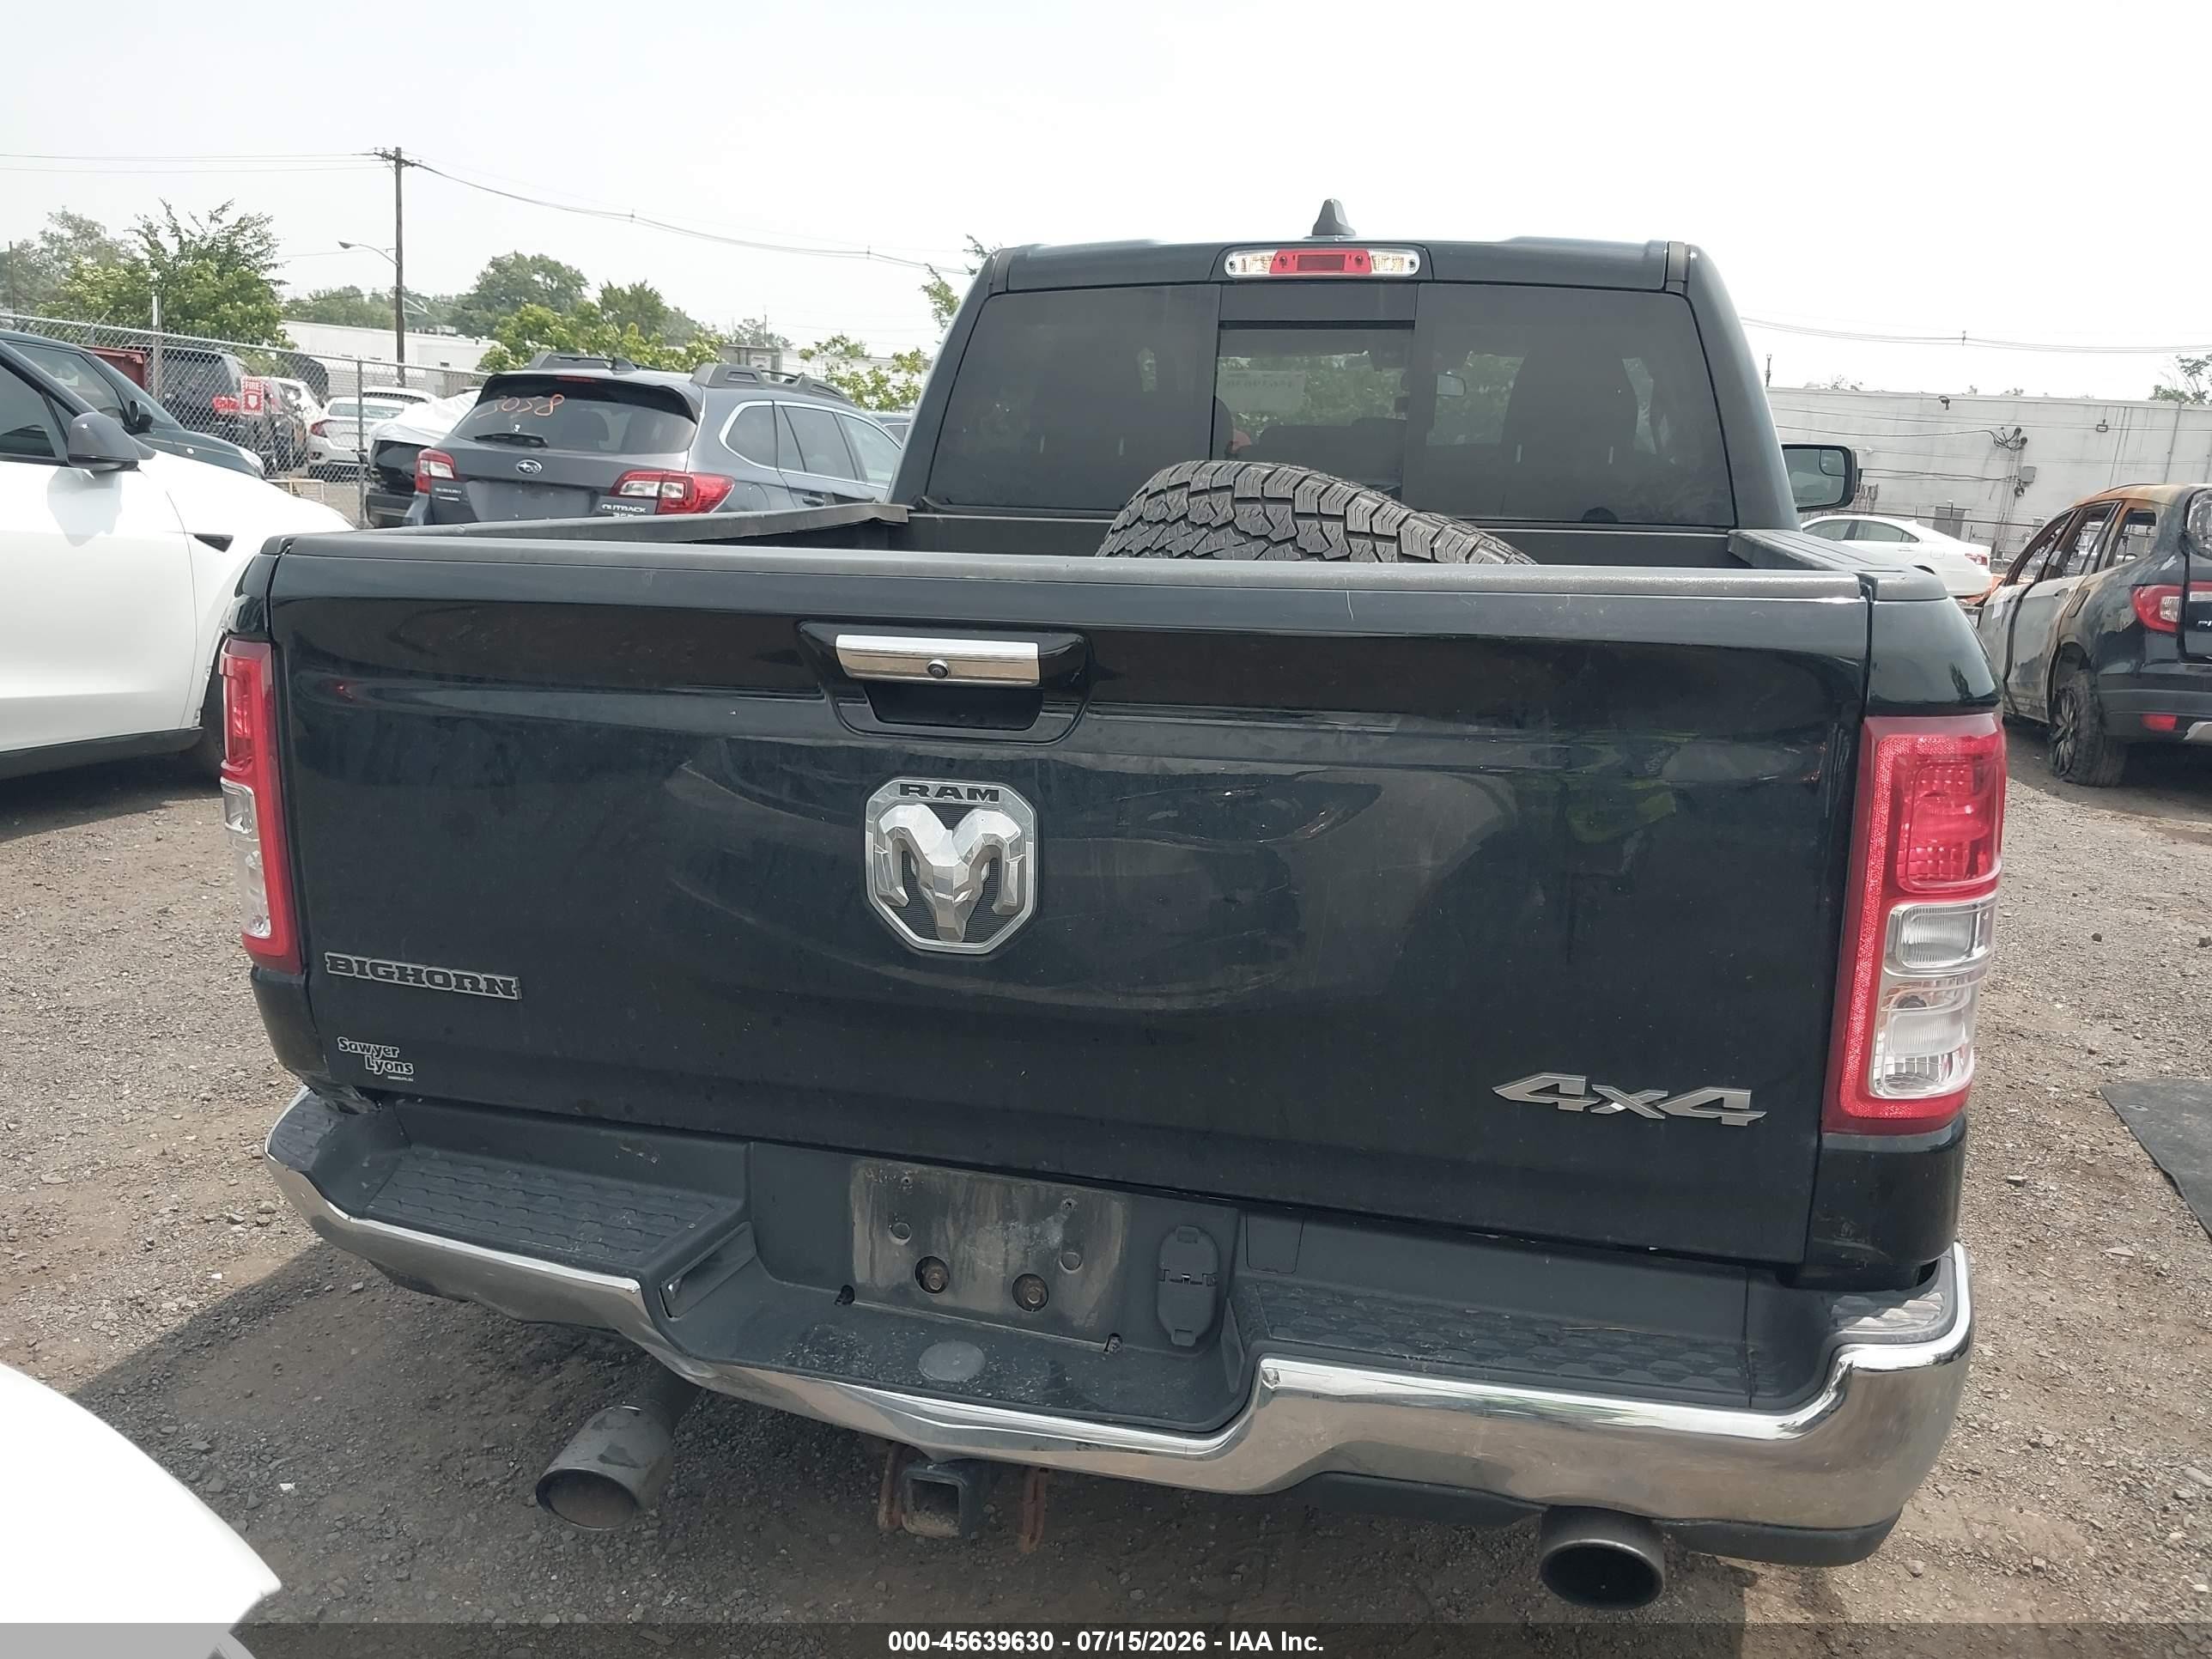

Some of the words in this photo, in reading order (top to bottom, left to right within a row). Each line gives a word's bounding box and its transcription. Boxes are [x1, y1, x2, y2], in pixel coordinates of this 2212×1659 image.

[245, 380, 262, 391] FIRE
[601, 503, 647, 514] OUTBACK
[899, 782, 1000, 803] RAM
[325, 951, 522, 1000] BIGHORN
[337, 1036, 399, 1059] Sawyer
[365, 1054, 414, 1075] Lyons
[1492, 1072, 1767, 1127] 4x4
